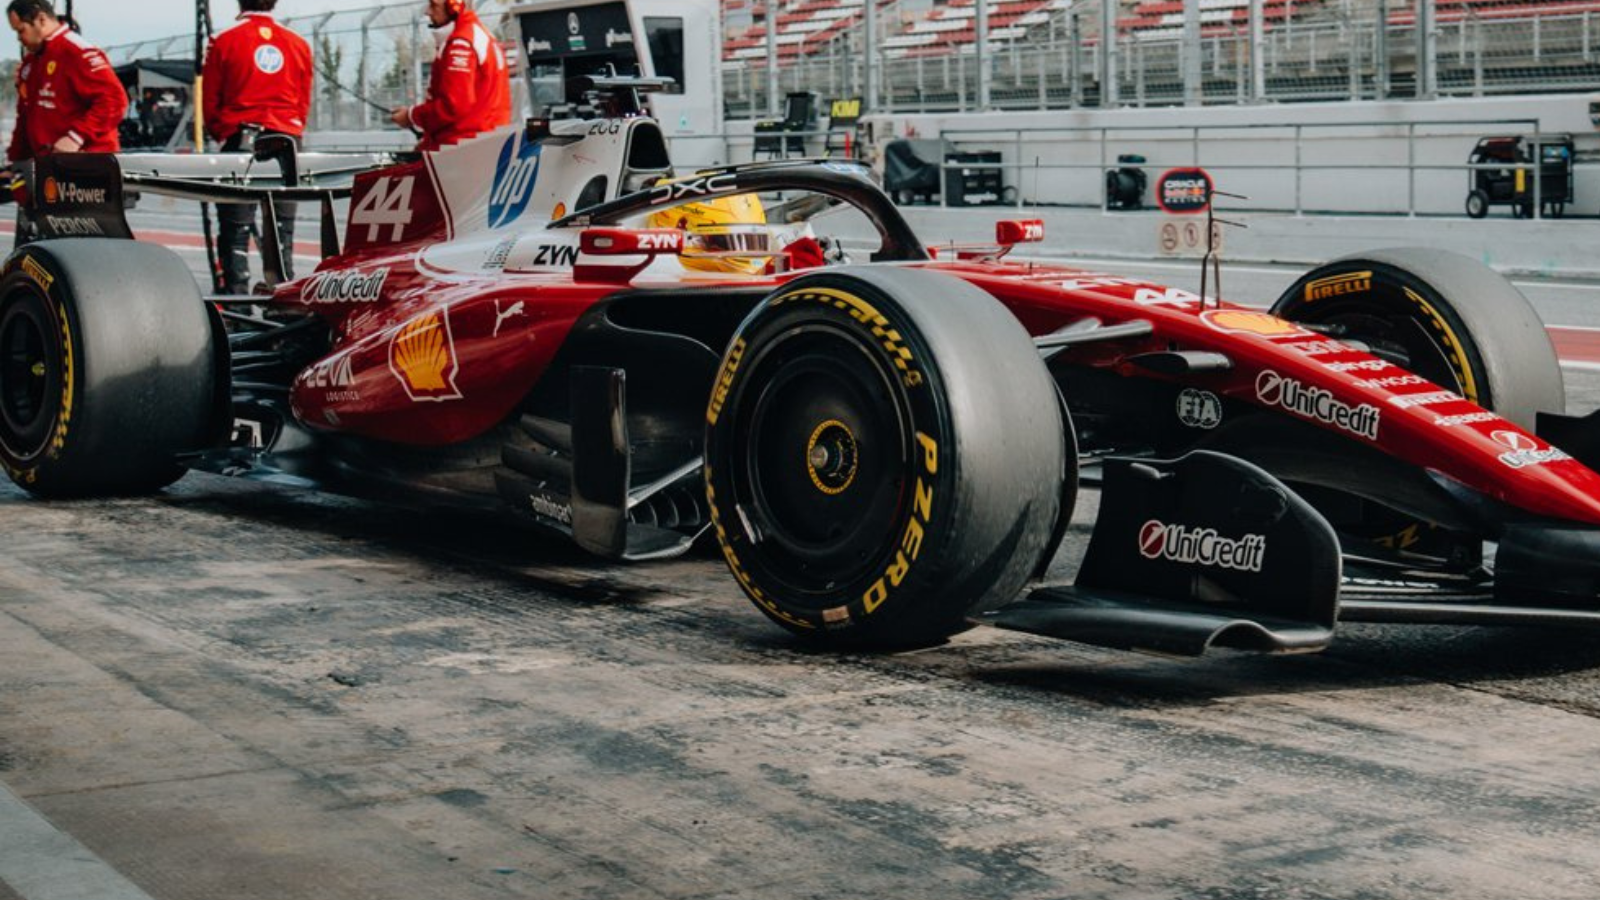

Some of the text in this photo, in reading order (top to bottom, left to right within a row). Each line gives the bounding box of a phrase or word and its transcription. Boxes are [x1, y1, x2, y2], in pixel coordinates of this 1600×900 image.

[57, 181, 106, 204] V-Power
[490, 126, 538, 229] hp
[351, 175, 415, 242] 44
[534, 245, 581, 267] ZYN
[637, 233, 680, 249] ZYN
[316, 266, 391, 303] UniCredit
[1134, 287, 1218, 309] 44
[1305, 270, 1372, 302] PIRELLI
[706, 337, 747, 426] PIRELLI
[1179, 394, 1218, 421] FIA
[1280, 378, 1380, 441] UniCredit
[1163, 524, 1266, 572] UniCredit
